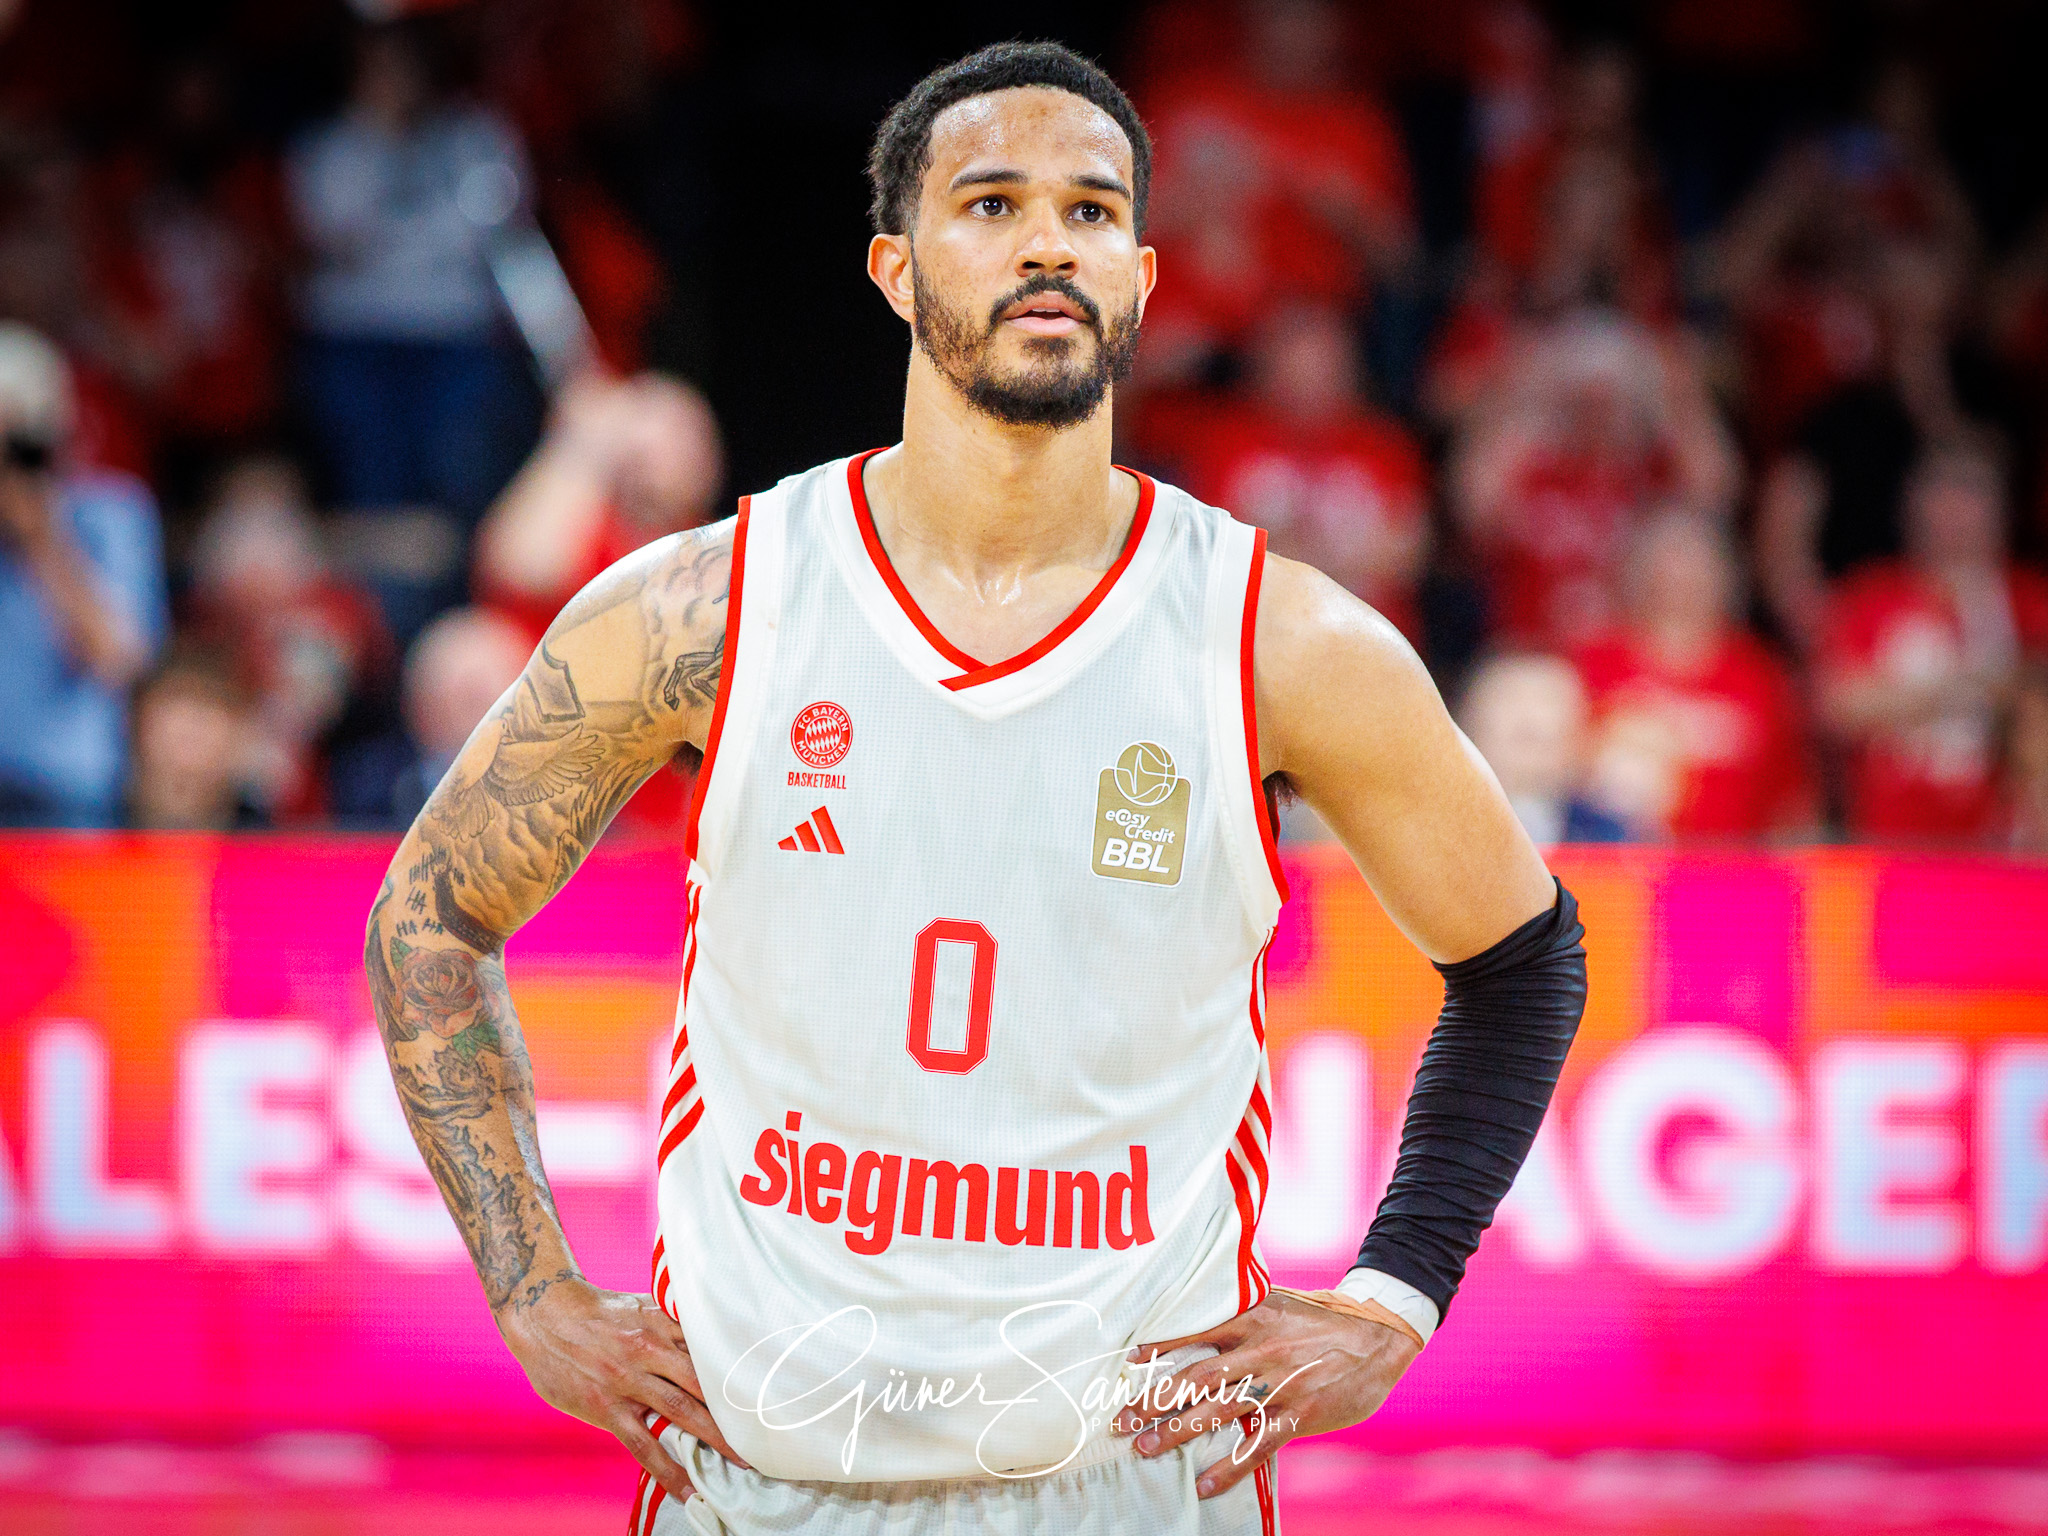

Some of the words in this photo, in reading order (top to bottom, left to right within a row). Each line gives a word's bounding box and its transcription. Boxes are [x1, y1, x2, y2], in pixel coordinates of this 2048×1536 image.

[798, 714, 811, 730] FC
[811, 706, 849, 732] BAYERN
[787, 771, 847, 790] BASKETBALL
[1124, 824, 1176, 844] Credit
[1101, 837, 1171, 874] BBL
[905, 917, 999, 1066] 0
[739, 1110, 1156, 1257] siegmund
